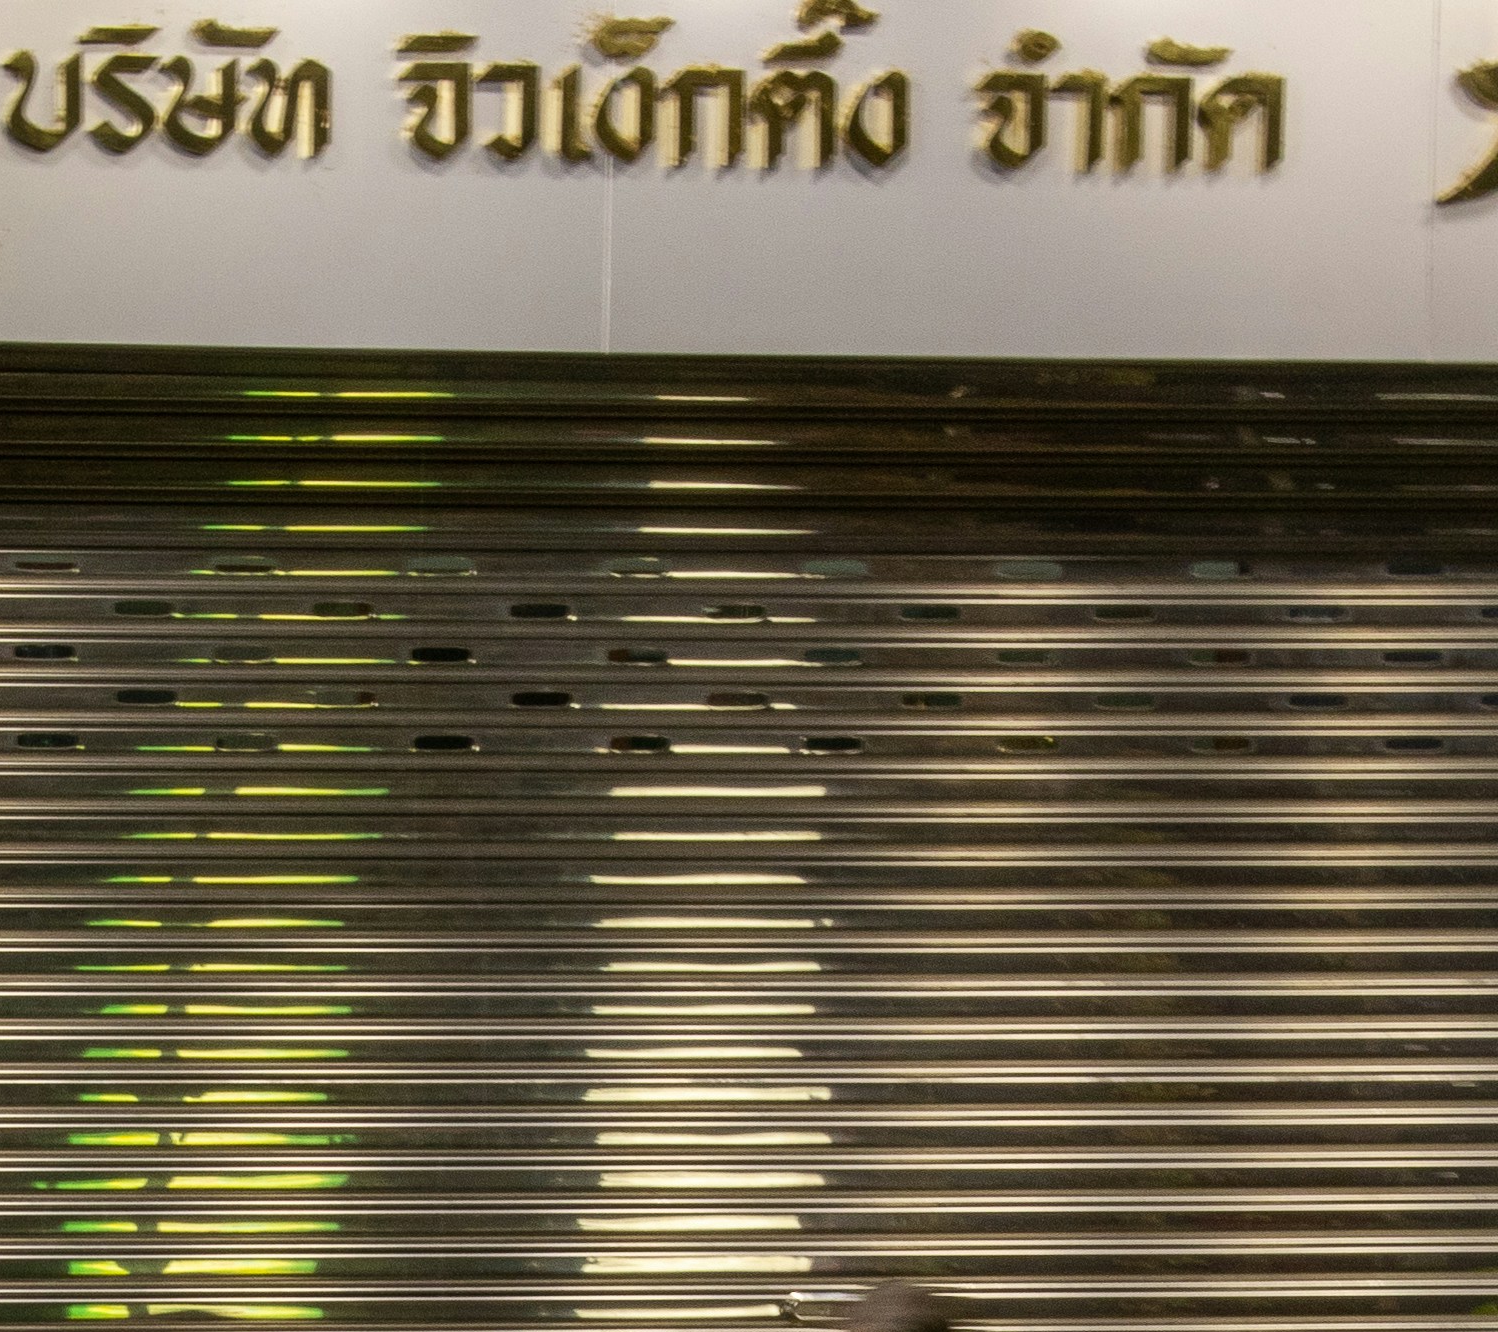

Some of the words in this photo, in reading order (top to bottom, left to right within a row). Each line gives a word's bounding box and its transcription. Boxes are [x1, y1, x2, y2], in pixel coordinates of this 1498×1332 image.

[0, 19, 330, 158] บริษัท
[972, 28, 1288, 174] จำกัด
